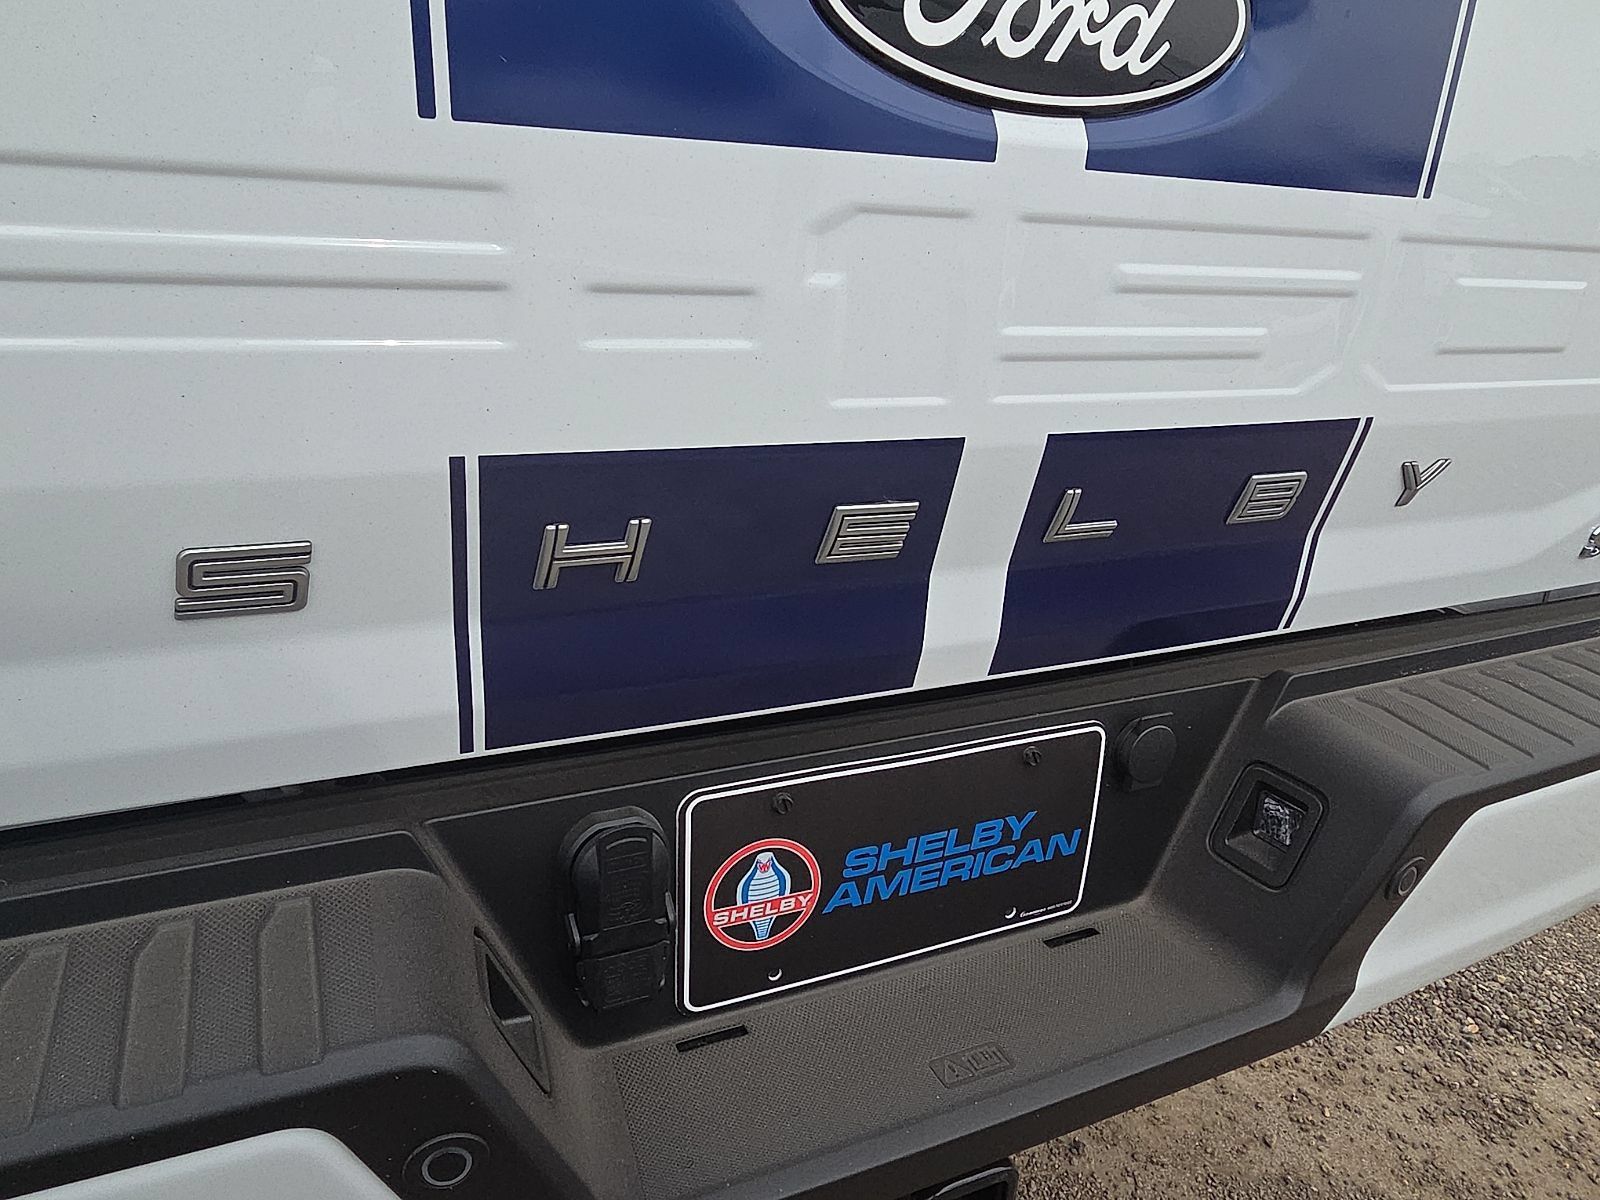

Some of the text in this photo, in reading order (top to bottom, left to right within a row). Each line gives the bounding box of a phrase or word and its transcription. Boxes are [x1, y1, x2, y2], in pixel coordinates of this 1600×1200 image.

[174, 457, 1452, 620] SHELBY
[822, 828, 1082, 915] AMERICAN
[843, 811, 1038, 878] SHELBY
[712, 893, 813, 926] SHELBY
